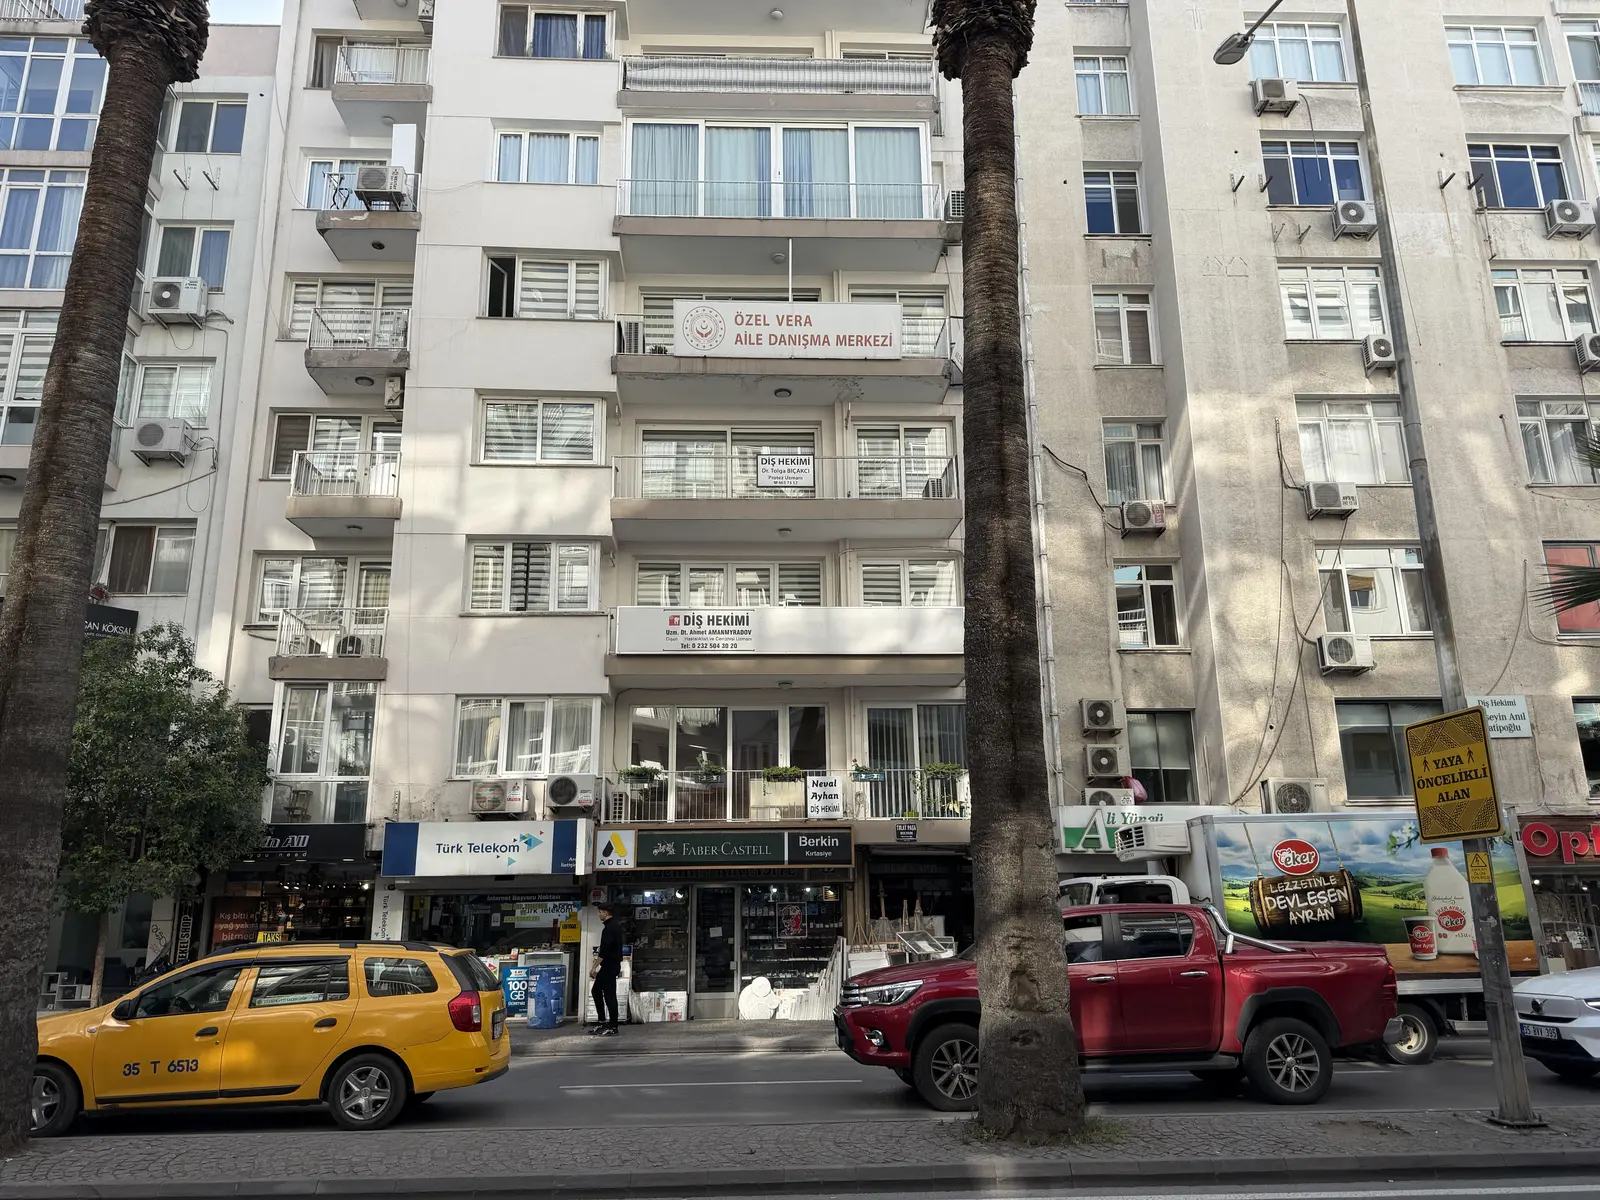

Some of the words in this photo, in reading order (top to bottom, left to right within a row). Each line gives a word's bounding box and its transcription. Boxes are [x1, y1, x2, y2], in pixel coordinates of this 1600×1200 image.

[734, 311, 770, 327] ÖZEL
[776, 314, 813, 327] VERA
[734, 330, 763, 346] AİLE
[768, 333, 831, 349] DANIŞMA
[835, 332, 893, 347] MERKEZİ
[761, 457, 776, 467] DİŞ
[778, 456, 811, 466] HEKİMİ
[683, 612, 703, 629] DİŞ
[707, 612, 750, 626] HEKİMİ
[1477, 699, 1490, 708] Diş
[1486, 712, 1507, 723] seyin
[1488, 723, 1522, 734] atipoğlu
[1432, 754, 1464, 770] YAYA
[811, 779, 837, 788] Neval
[1416, 764, 1489, 790] ÖNCELİKLİ
[810, 792, 839, 801] Ayhan
[1437, 788, 1471, 803] ALAN
[810, 803, 820, 814] DİŞ
[820, 802, 840, 813] HEKİMİ
[435, 843, 463, 854] Türk
[467, 841, 520, 854] Telekom
[798, 835, 839, 848] Berkin
[805, 850, 832, 858] Kırtasiye
[1284, 850, 1316, 867] eker
[1269, 875, 1338, 894] LEZZETİYLE
[382, 894, 390, 910] Türk
[1264, 886, 1350, 912] DEVLEŞEN
[1289, 906, 1336, 926] AYRAN
[1445, 917, 1465, 928] eker
[380, 911, 389, 939] Telekom
[507, 981, 528, 991] 100
[510, 990, 525, 1000] GB
[122, 1062, 141, 1077] 35
[150, 1060, 161, 1074] T
[167, 1059, 199, 1073] 6513
